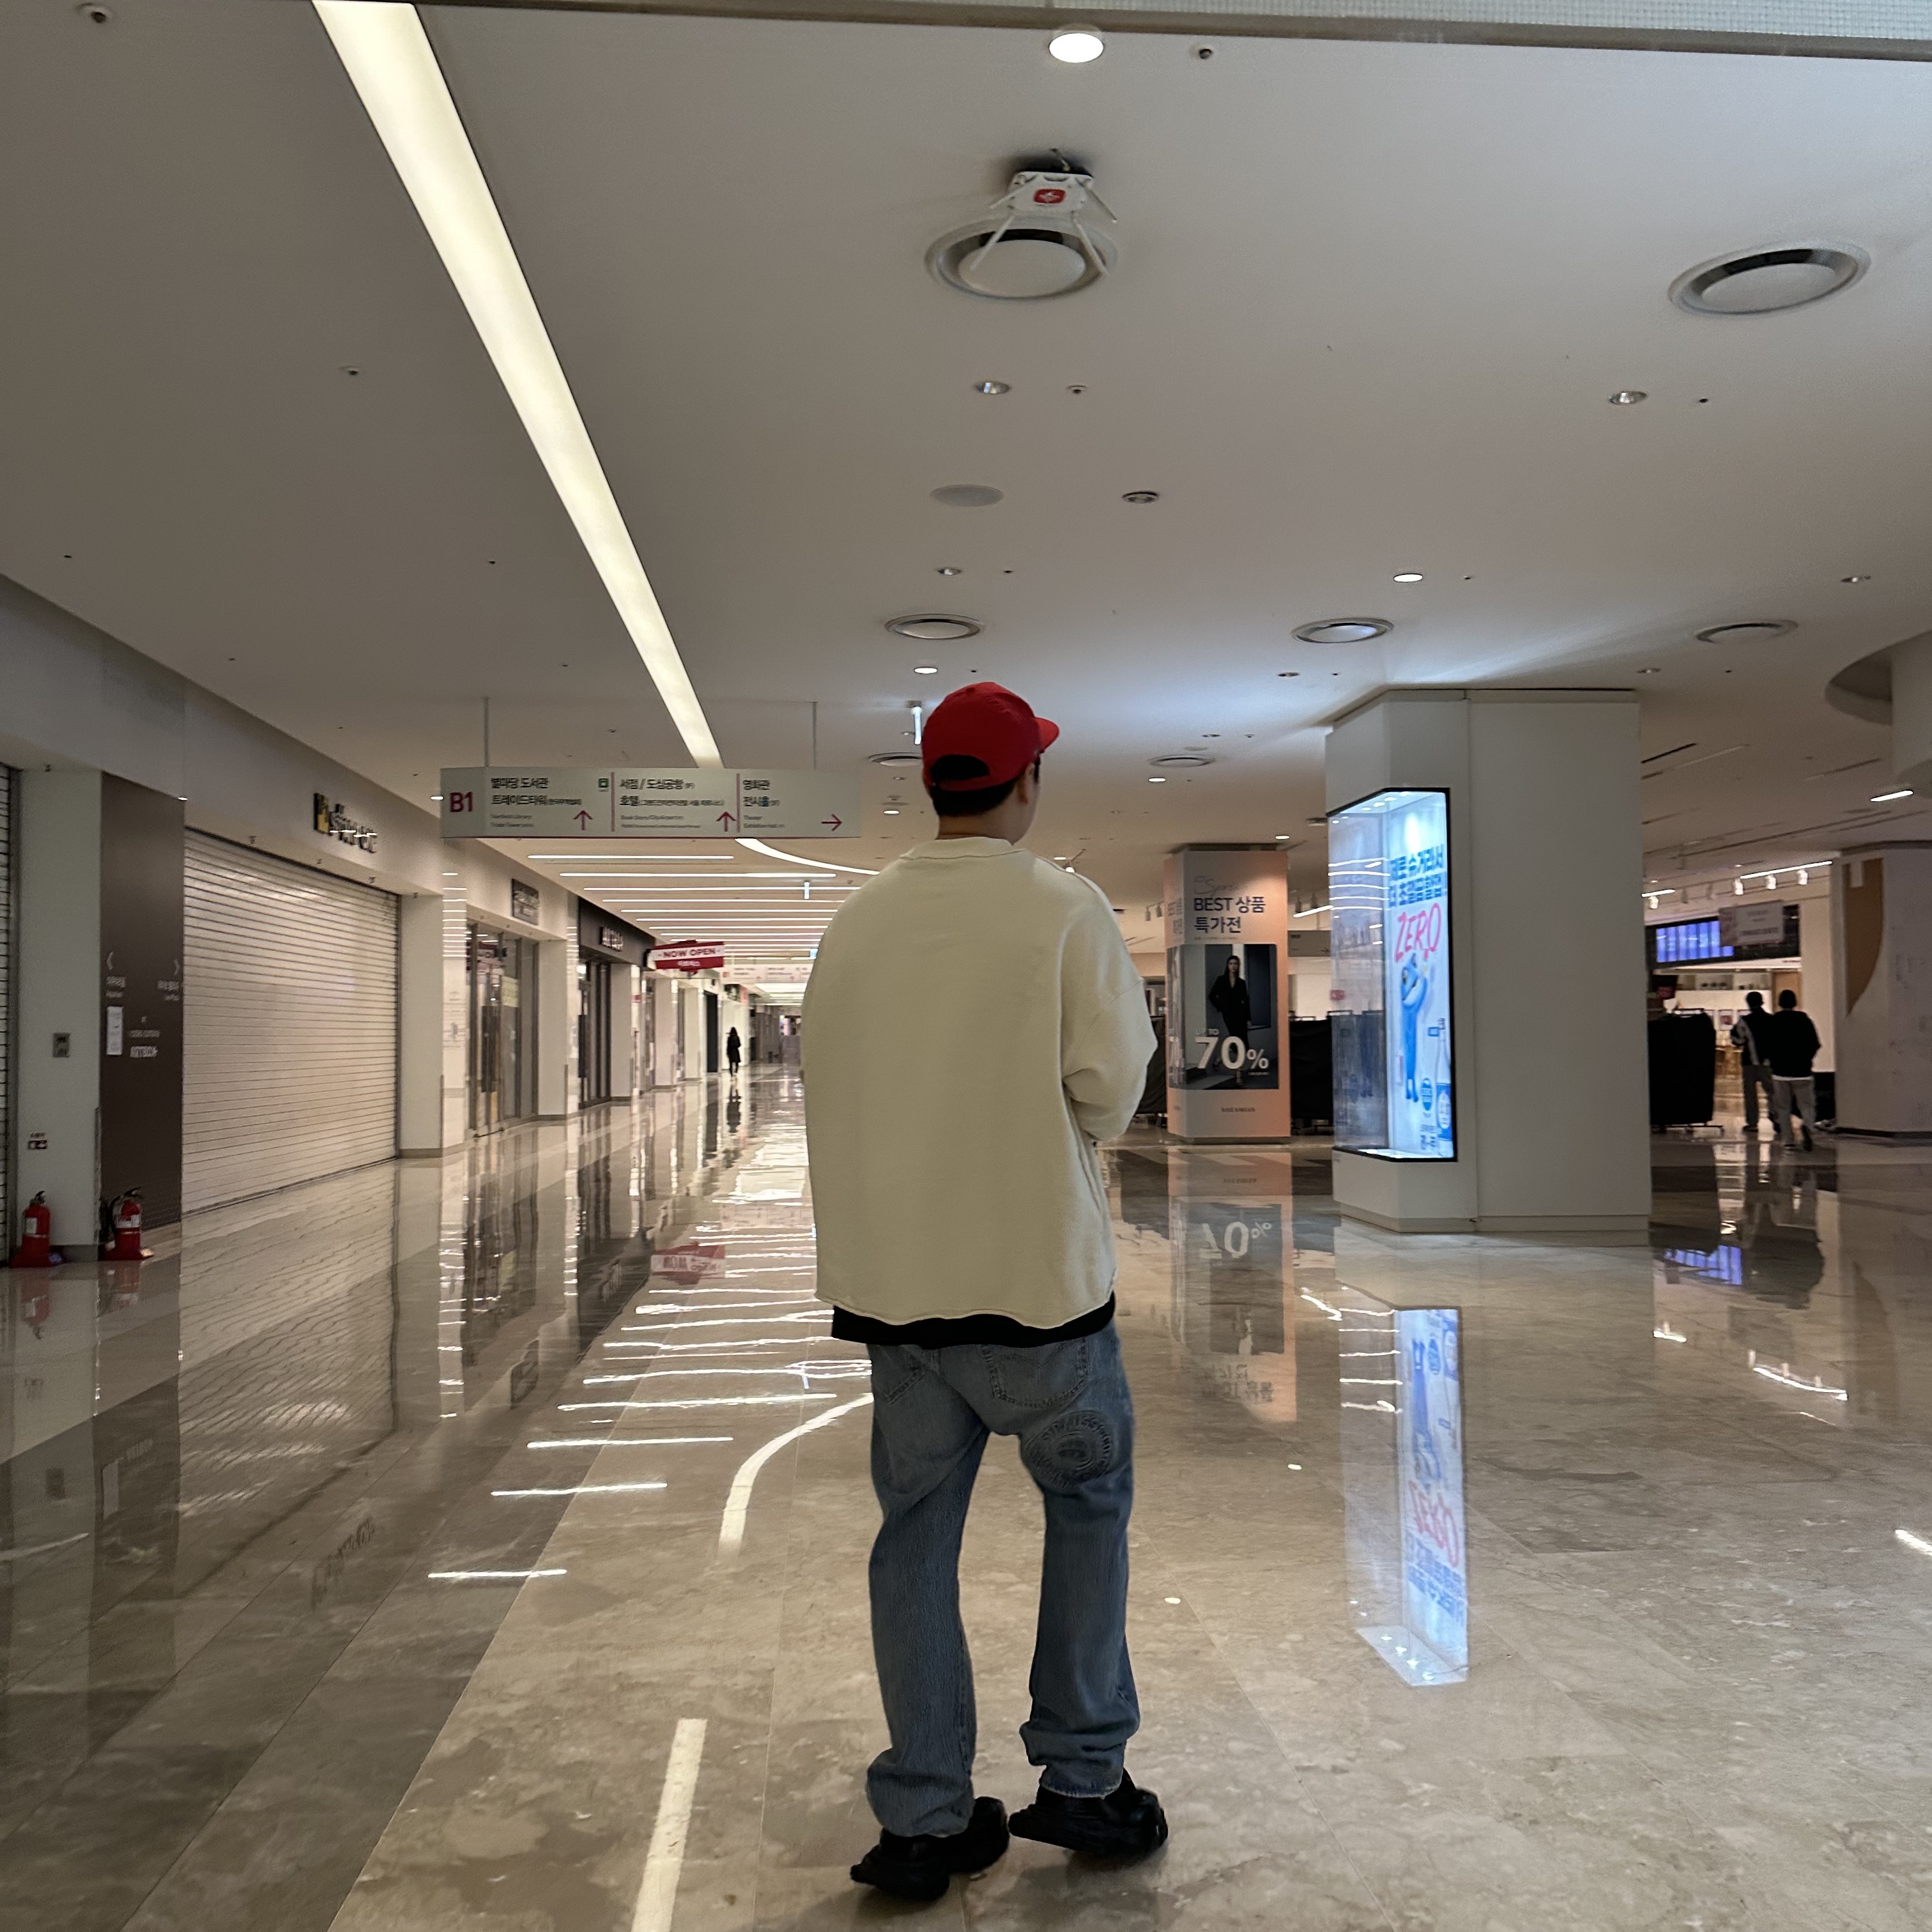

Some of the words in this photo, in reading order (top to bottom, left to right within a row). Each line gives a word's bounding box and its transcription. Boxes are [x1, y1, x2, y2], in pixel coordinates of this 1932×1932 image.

[449, 792, 473, 812] B1
[1193, 897, 1233, 911] BEST
[1236, 896, 1266, 914] 상품
[1194, 916, 1241, 933] 특가전
[690, 948, 716, 956] OPEN
[1195, 1036, 1269, 1070] 70%
